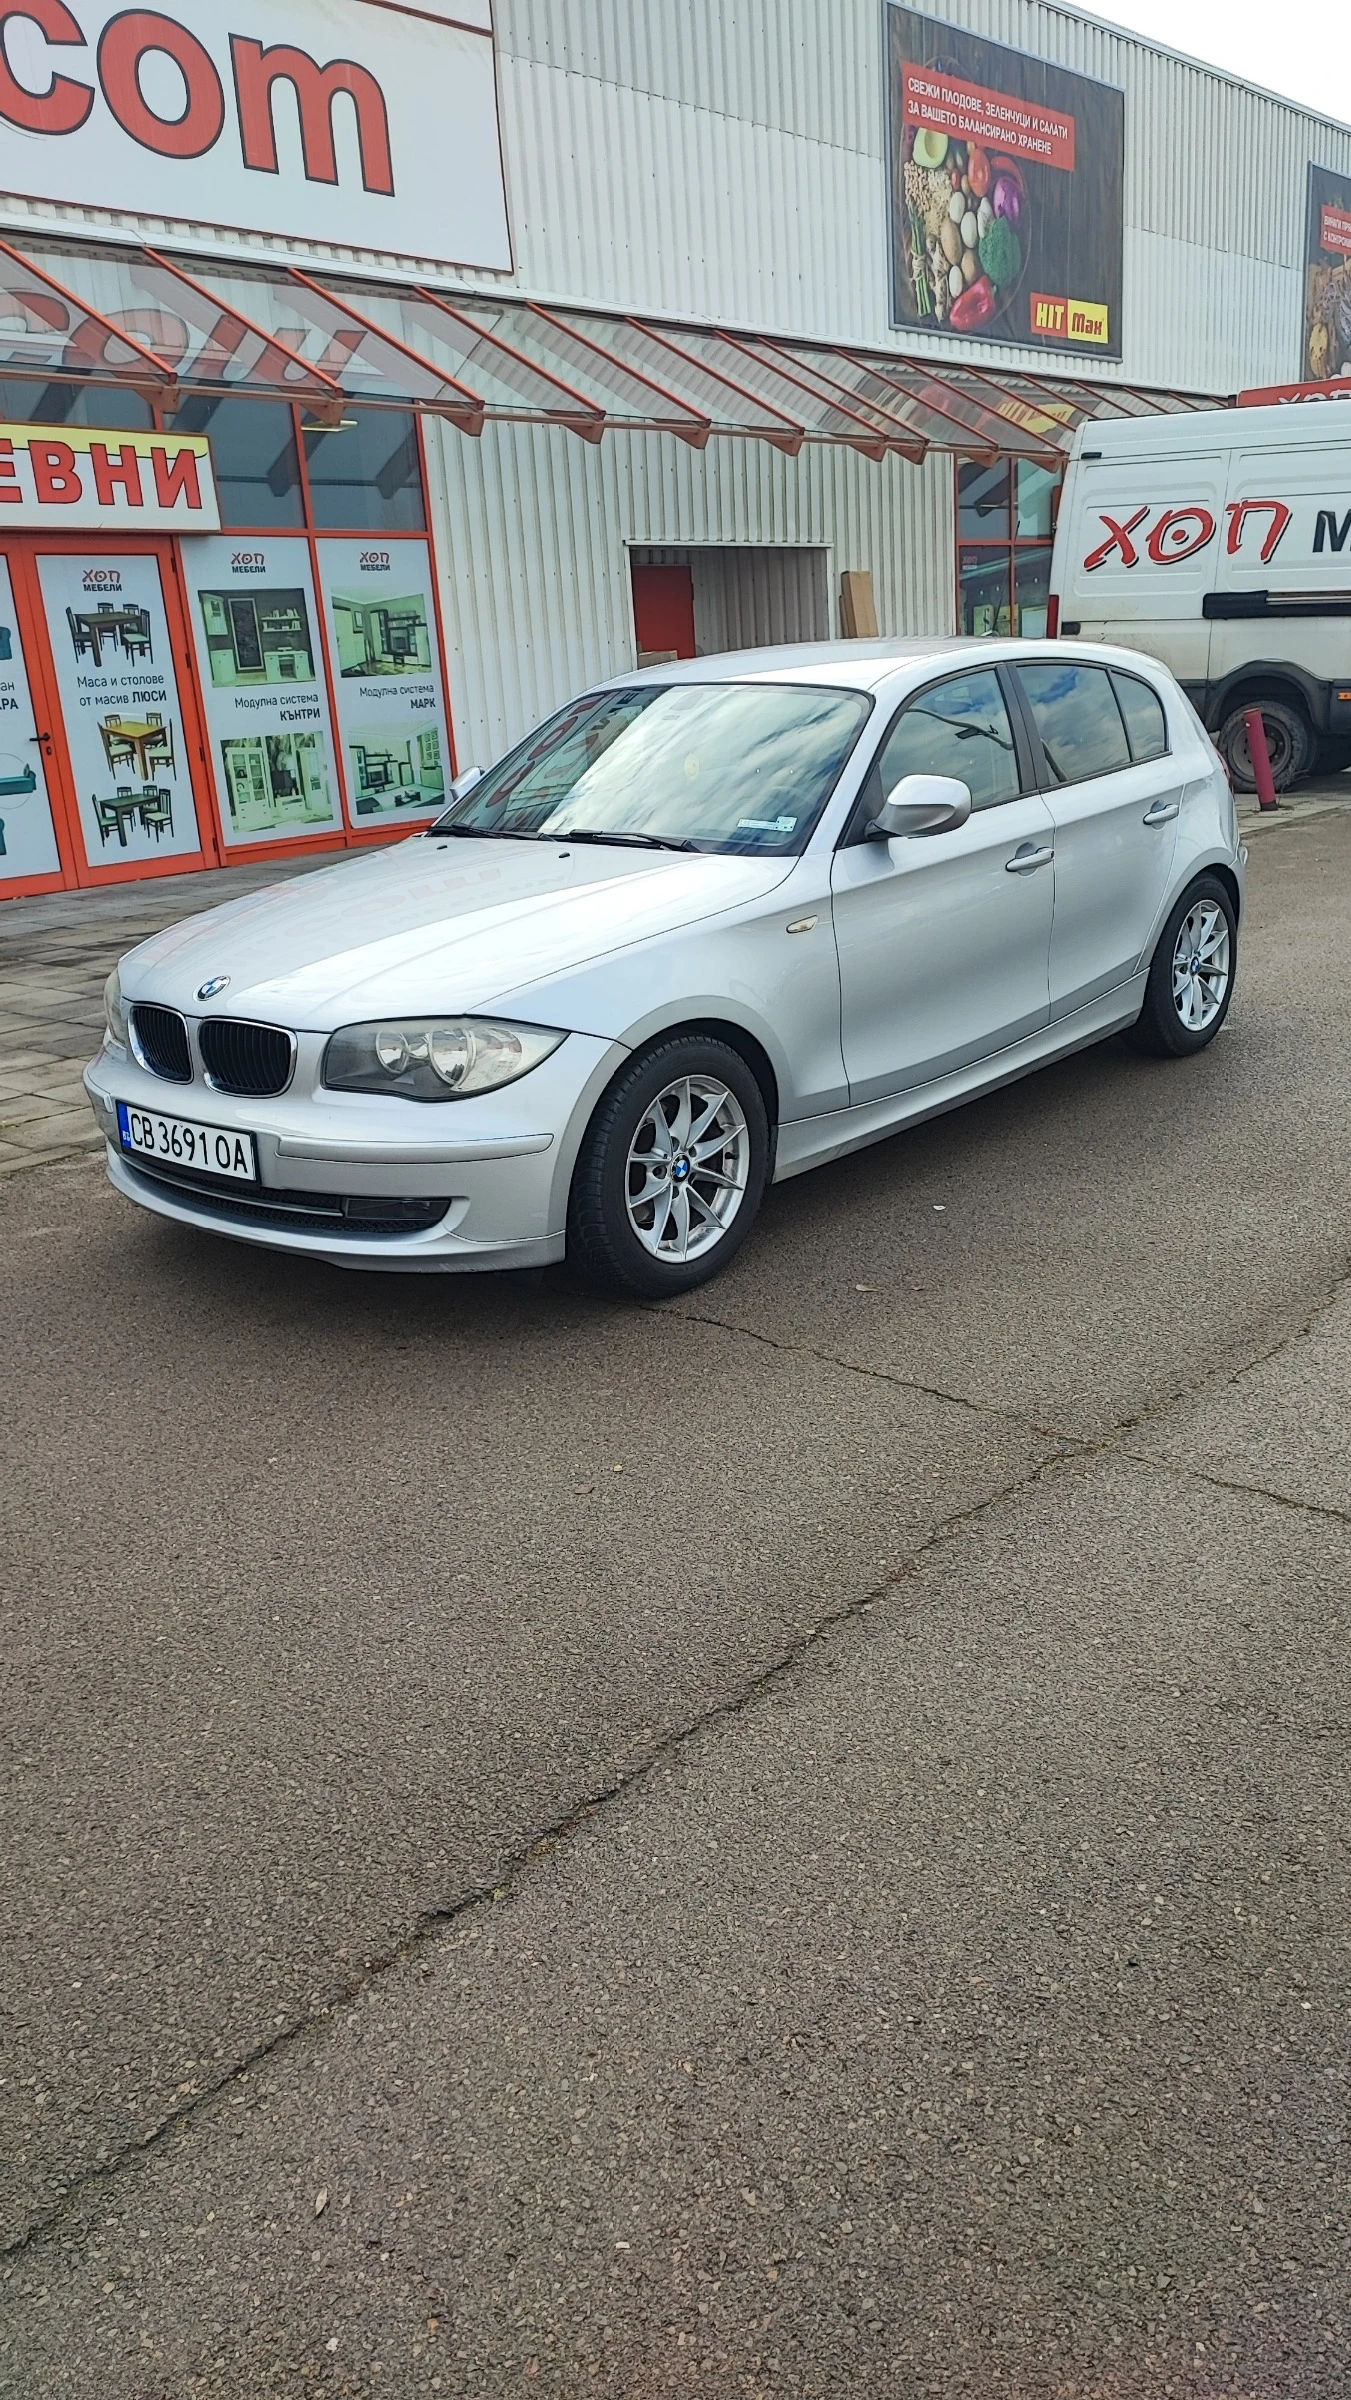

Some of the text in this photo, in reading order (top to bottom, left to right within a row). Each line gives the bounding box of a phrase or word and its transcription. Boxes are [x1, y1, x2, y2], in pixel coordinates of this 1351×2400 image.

[0, 0, 394, 196] com
[908, 77, 1068, 140] СВЕЖИ ПЛОДОВЕ, ЗЕЛЕНЧУЦИ И САЛАТИ
[908, 101, 1052, 155] ЗА ВАШЕТО БАЛАНСИРАНО ХРАНЕНЕ
[1036, 302, 1065, 330] HIT
[1083, 500, 1293, 571] ХОП
[231, 552, 265, 566] ХОП
[359, 551, 390, 564] ХОП
[232, 565, 266, 574] МЕБЕЛИ
[360, 563, 391, 572] МЕБЕЛИ
[82, 569, 121, 584] ХОП
[83, 583, 122, 592] МЕБЕЛИ
[77, 674, 165, 688] Маса и столове
[359, 683, 435, 698] Модулна система
[0, 697, 19, 710] РА
[79, 690, 168, 707] от масив ЛЮСИ
[234, 693, 319, 709] Модулна система
[410, 697, 436, 710] МАРК
[279, 707, 321, 721] КЪНТРИ
[130, 1113, 249, 1174] CB 3691 OA
